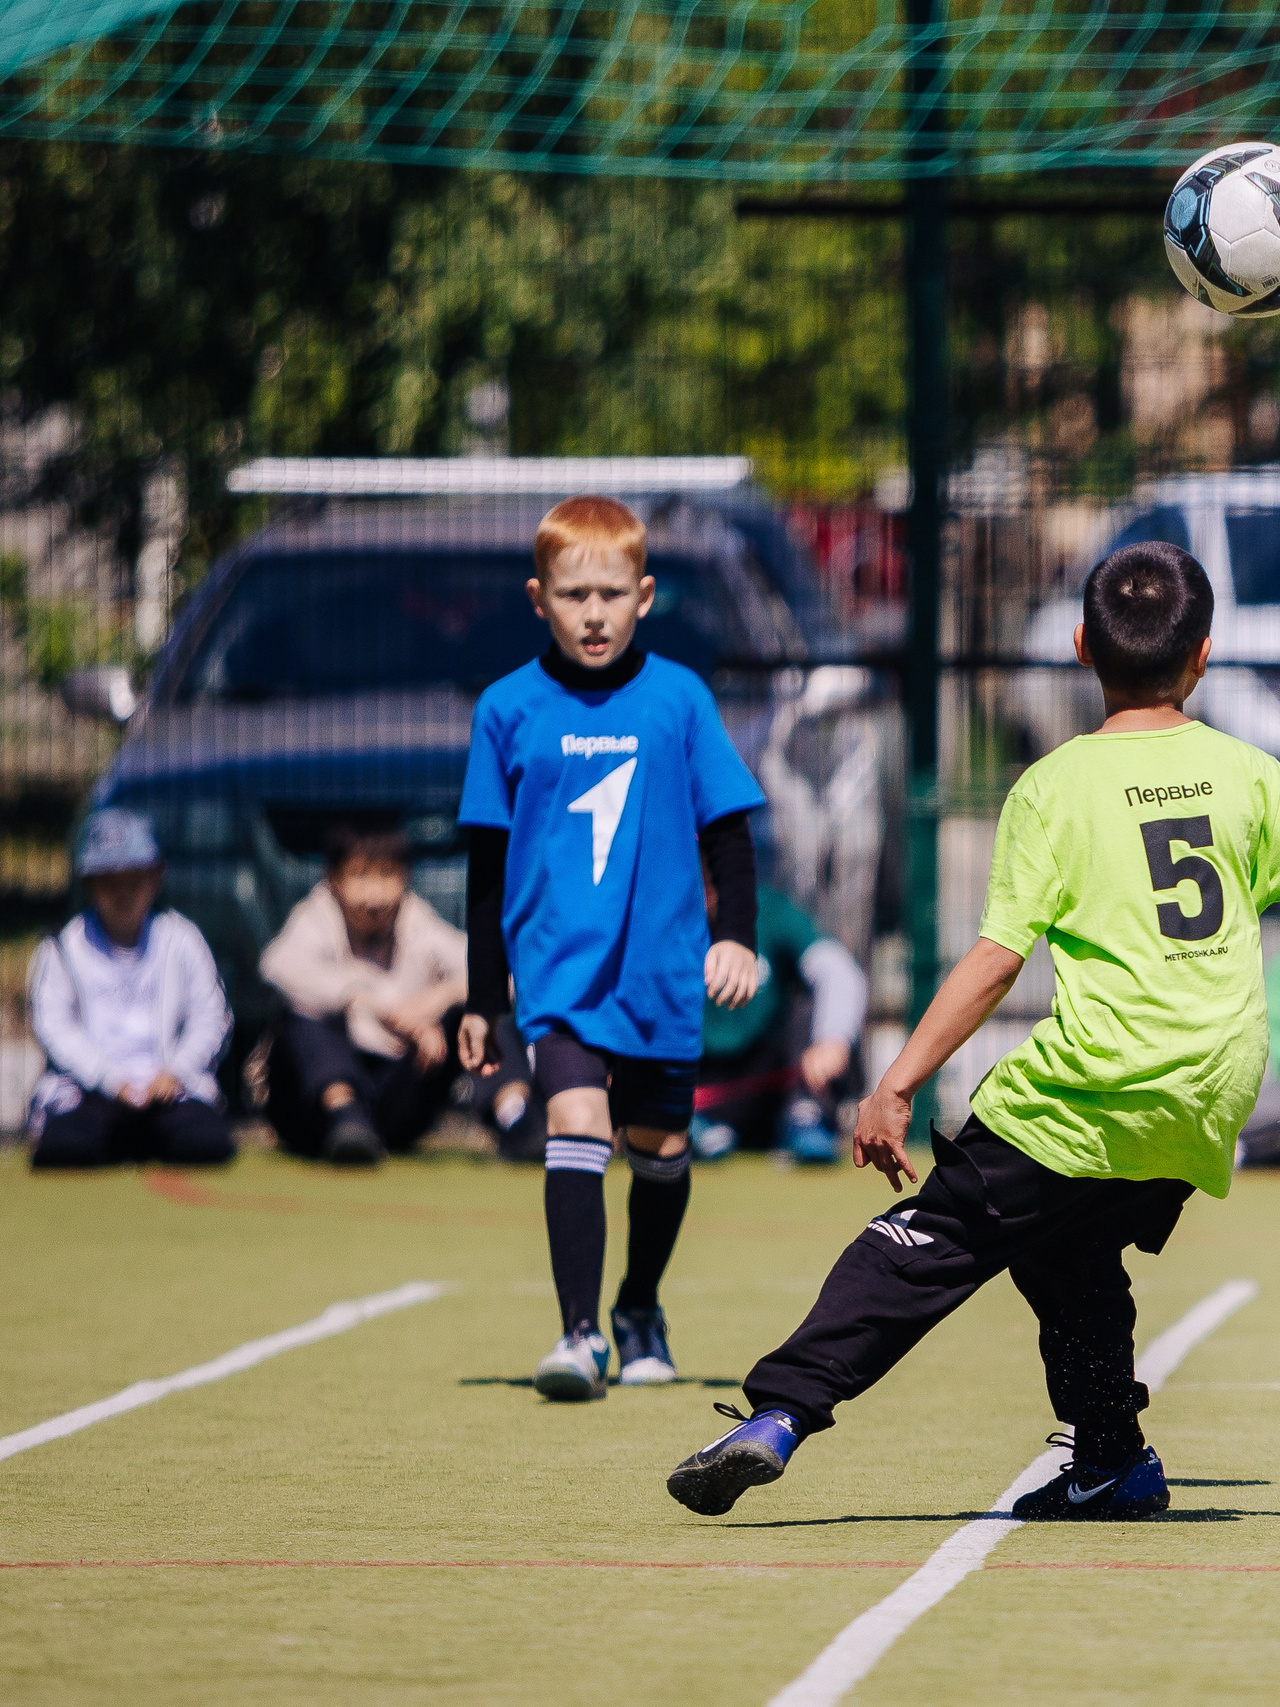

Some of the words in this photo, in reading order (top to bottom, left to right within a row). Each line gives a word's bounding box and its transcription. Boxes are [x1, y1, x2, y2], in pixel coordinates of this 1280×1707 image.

[561, 733, 639, 760] Первые
[1124, 781, 1214, 807] Первые
[1139, 814, 1224, 942] 5
[1164, 946, 1229, 962] METROSHKA.RU
